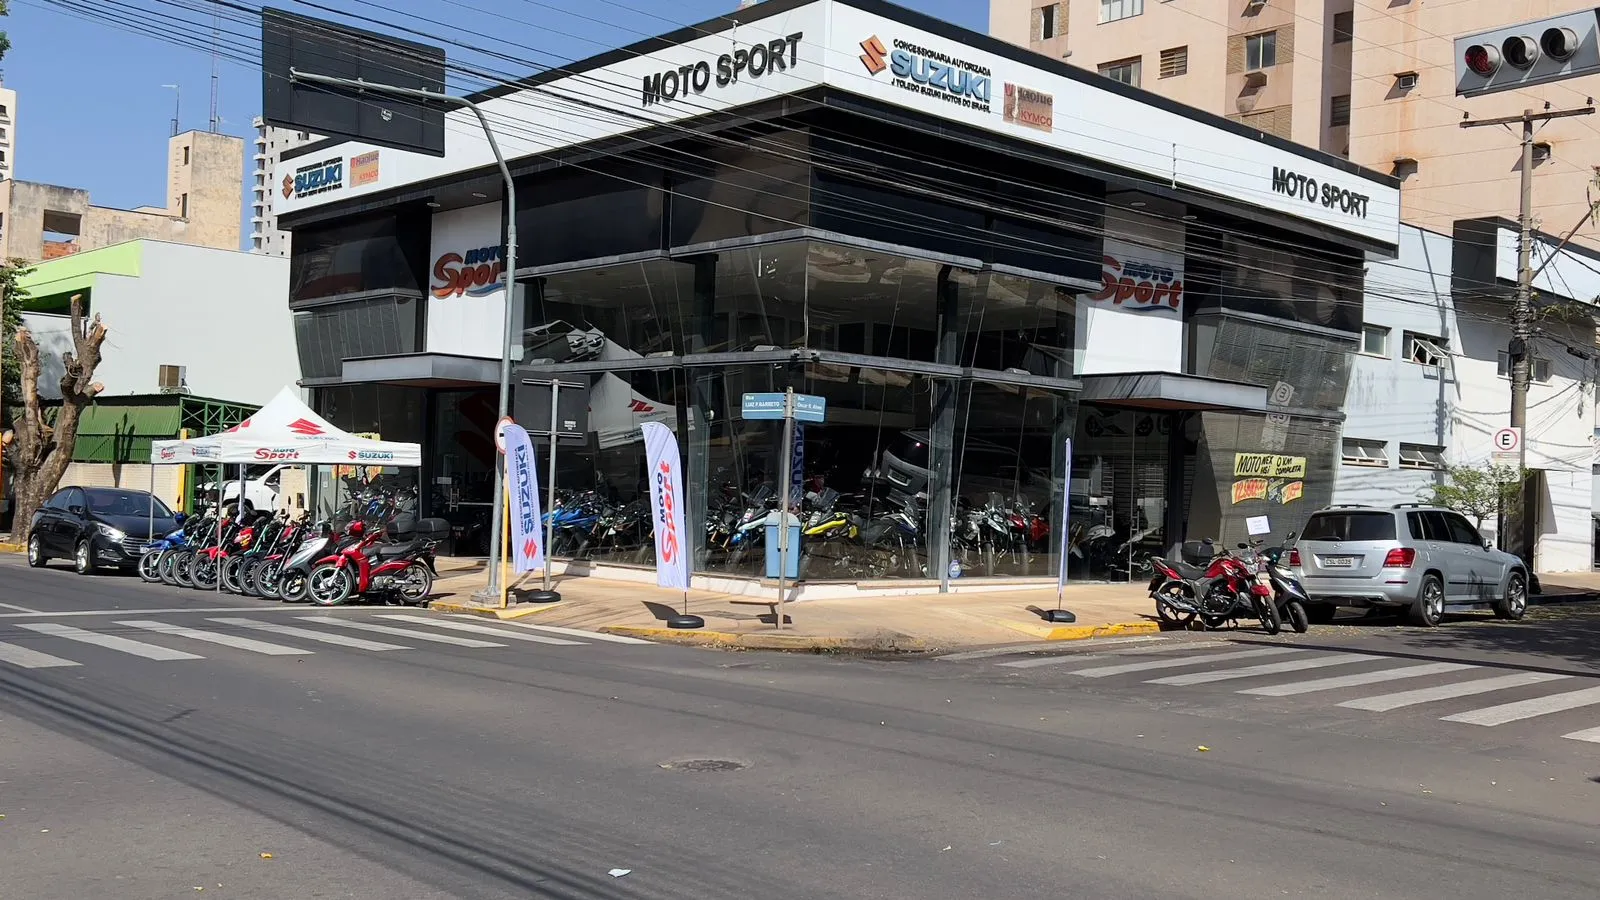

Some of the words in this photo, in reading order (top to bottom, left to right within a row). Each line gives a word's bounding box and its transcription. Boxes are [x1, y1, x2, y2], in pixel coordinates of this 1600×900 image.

[642, 61, 710, 106] MOTO
[716, 31, 803, 88] SPORT
[890, 49, 992, 103] SUZUKI
[893, 38, 951, 64] CONCESSIONARIA
[951, 58, 992, 77] AUTORIZADA
[896, 79, 920, 93] TOLEDO
[920, 86, 941, 99] SUZUKI
[942, 92, 962, 106] MOTOS
[962, 99, 971, 108] DO
[1020, 110, 1052, 127] KYMCO
[294, 163, 343, 193] SUZUKI
[1272, 166, 1318, 203] MOTO
[1321, 182, 1370, 219] SPORT
[431, 252, 507, 298] Spor
[1085, 255, 1183, 308] Sport
[254, 447, 300, 460] Sport
[1502, 434, 1510, 445] E
[1236, 455, 1261, 473] MOTO
[1261, 456, 1274, 465] NEX
[1275, 465, 1301, 476] COMPLETA
[519, 444, 534, 534] SUZUKI
[657, 472, 665, 523] MOTO
[660, 461, 678, 564] Sport
